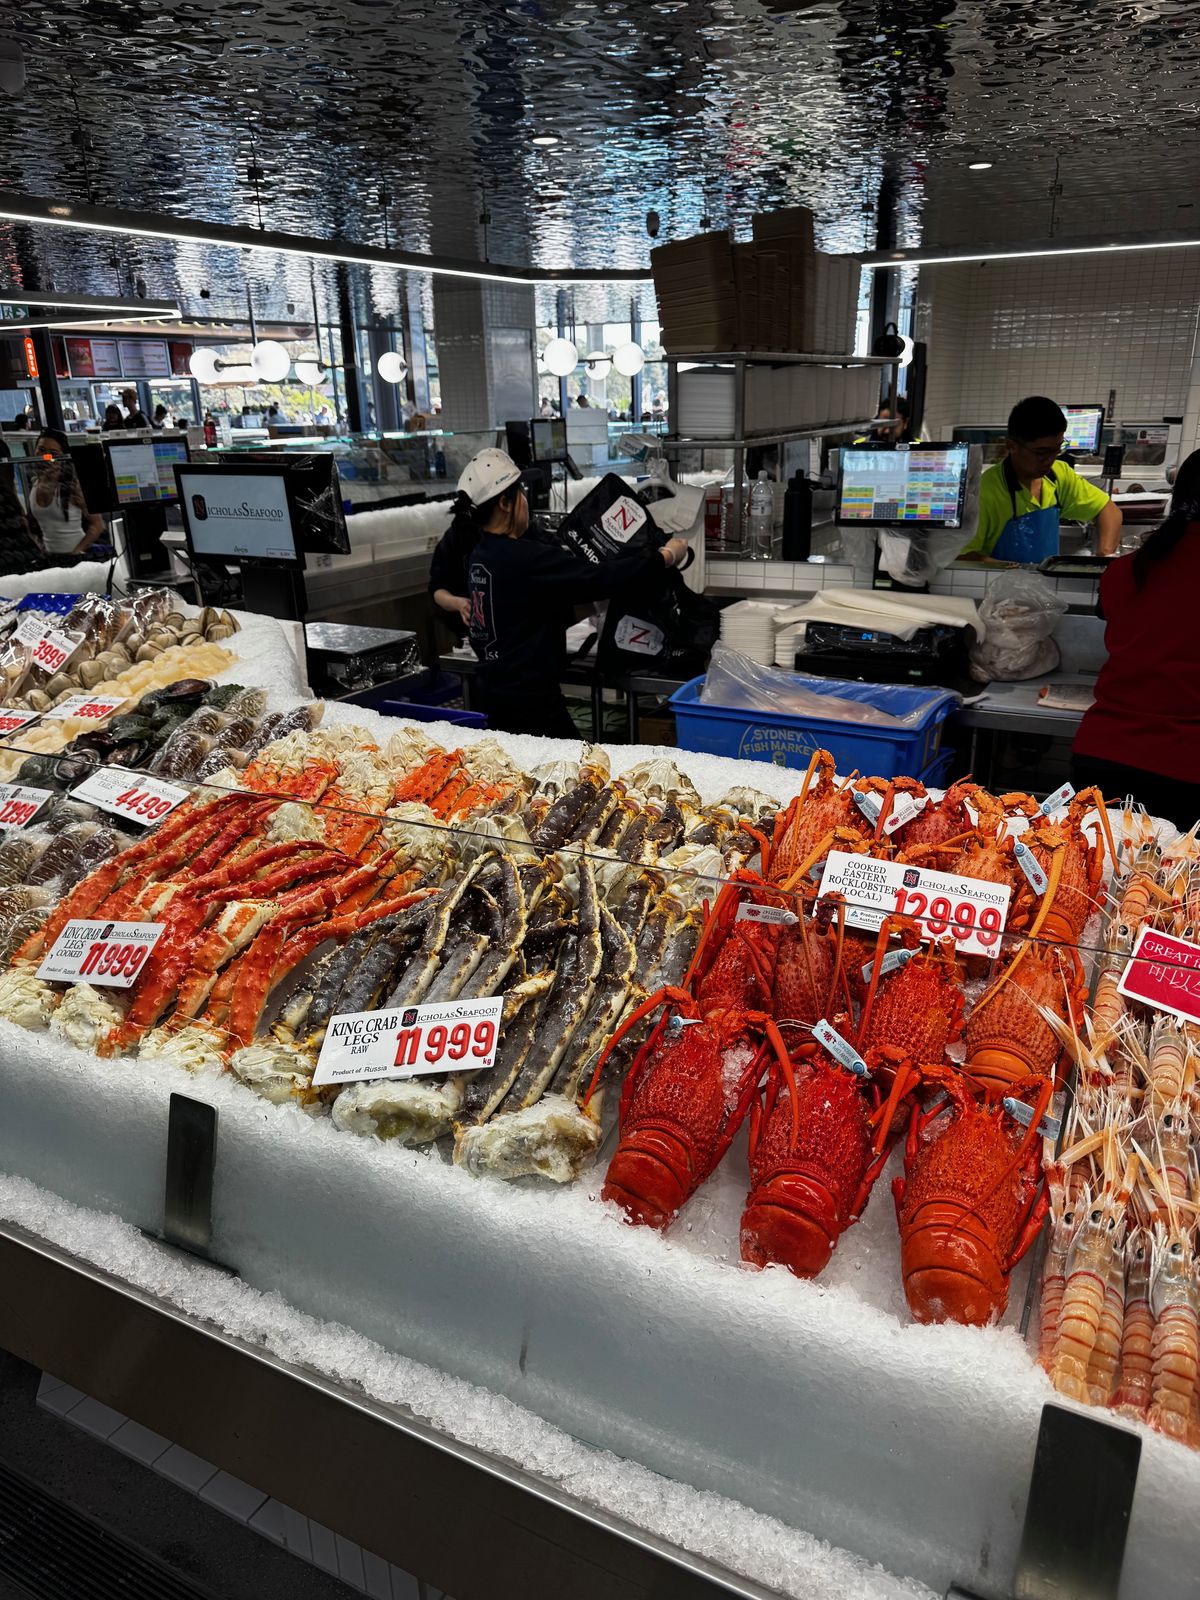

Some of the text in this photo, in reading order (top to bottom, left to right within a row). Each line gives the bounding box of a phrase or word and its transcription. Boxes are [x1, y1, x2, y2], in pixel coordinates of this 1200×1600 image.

[753, 728, 804, 742] SYDNEY
[743, 741, 769, 755] FISH
[847, 860, 887, 874] COOKED
[843, 868, 887, 884] EASTERN
[828, 875, 898, 896] ROCKLOBSTER
[839, 886, 883, 903] (LOCAL)
[859, 916, 880, 924] Australia
[860, 911, 878, 919] Product
[62, 926, 101, 941] KING CRAB
[64, 940, 86, 950] LEGS
[986, 947, 996, 957] kg
[1144, 940, 1193, 964] GREAT
[56, 949, 83, 958] COOKED
[331, 1015, 398, 1037] KING CRAB
[343, 1032, 380, 1047] LEGS
[350, 1044, 369, 1055] RAW
[482, 1057, 492, 1066] kg
[331, 1068, 355, 1077] Product
[363, 1065, 388, 1073] Russia
